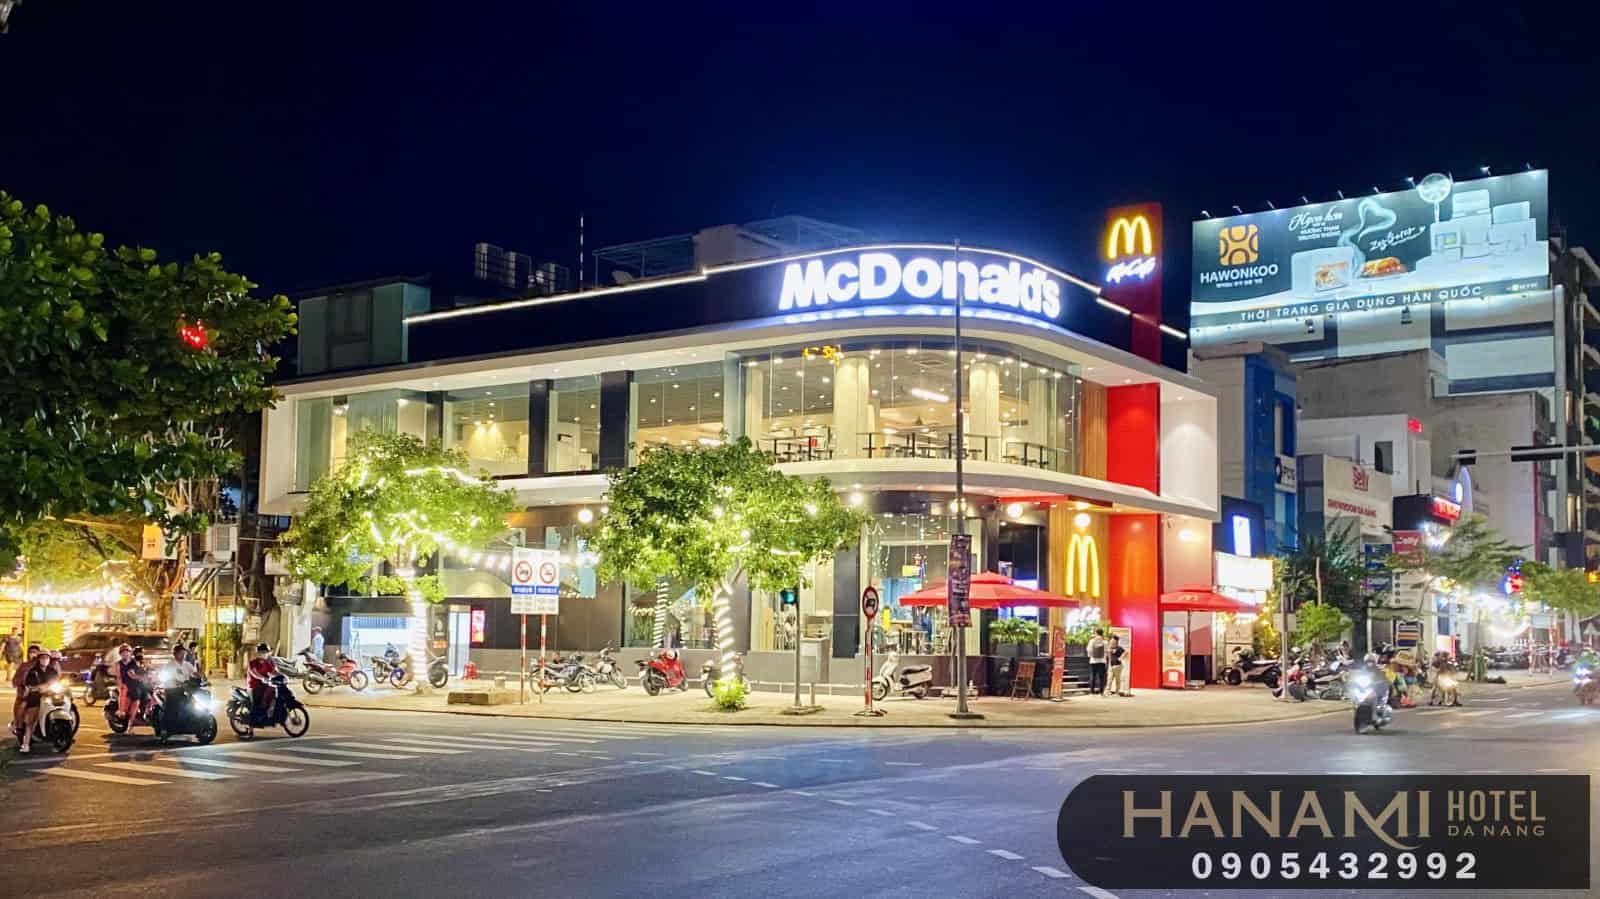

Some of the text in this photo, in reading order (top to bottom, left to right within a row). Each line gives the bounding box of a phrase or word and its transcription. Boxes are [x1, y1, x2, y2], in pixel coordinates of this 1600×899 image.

[778, 252, 1061, 319] McDonald's
[1200, 263, 1279, 284] HAWONKOO
[1276, 304, 1319, 318] TRANG
[1326, 301, 1350, 312] GIA
[1439, 285, 1482, 300] QUỐC
